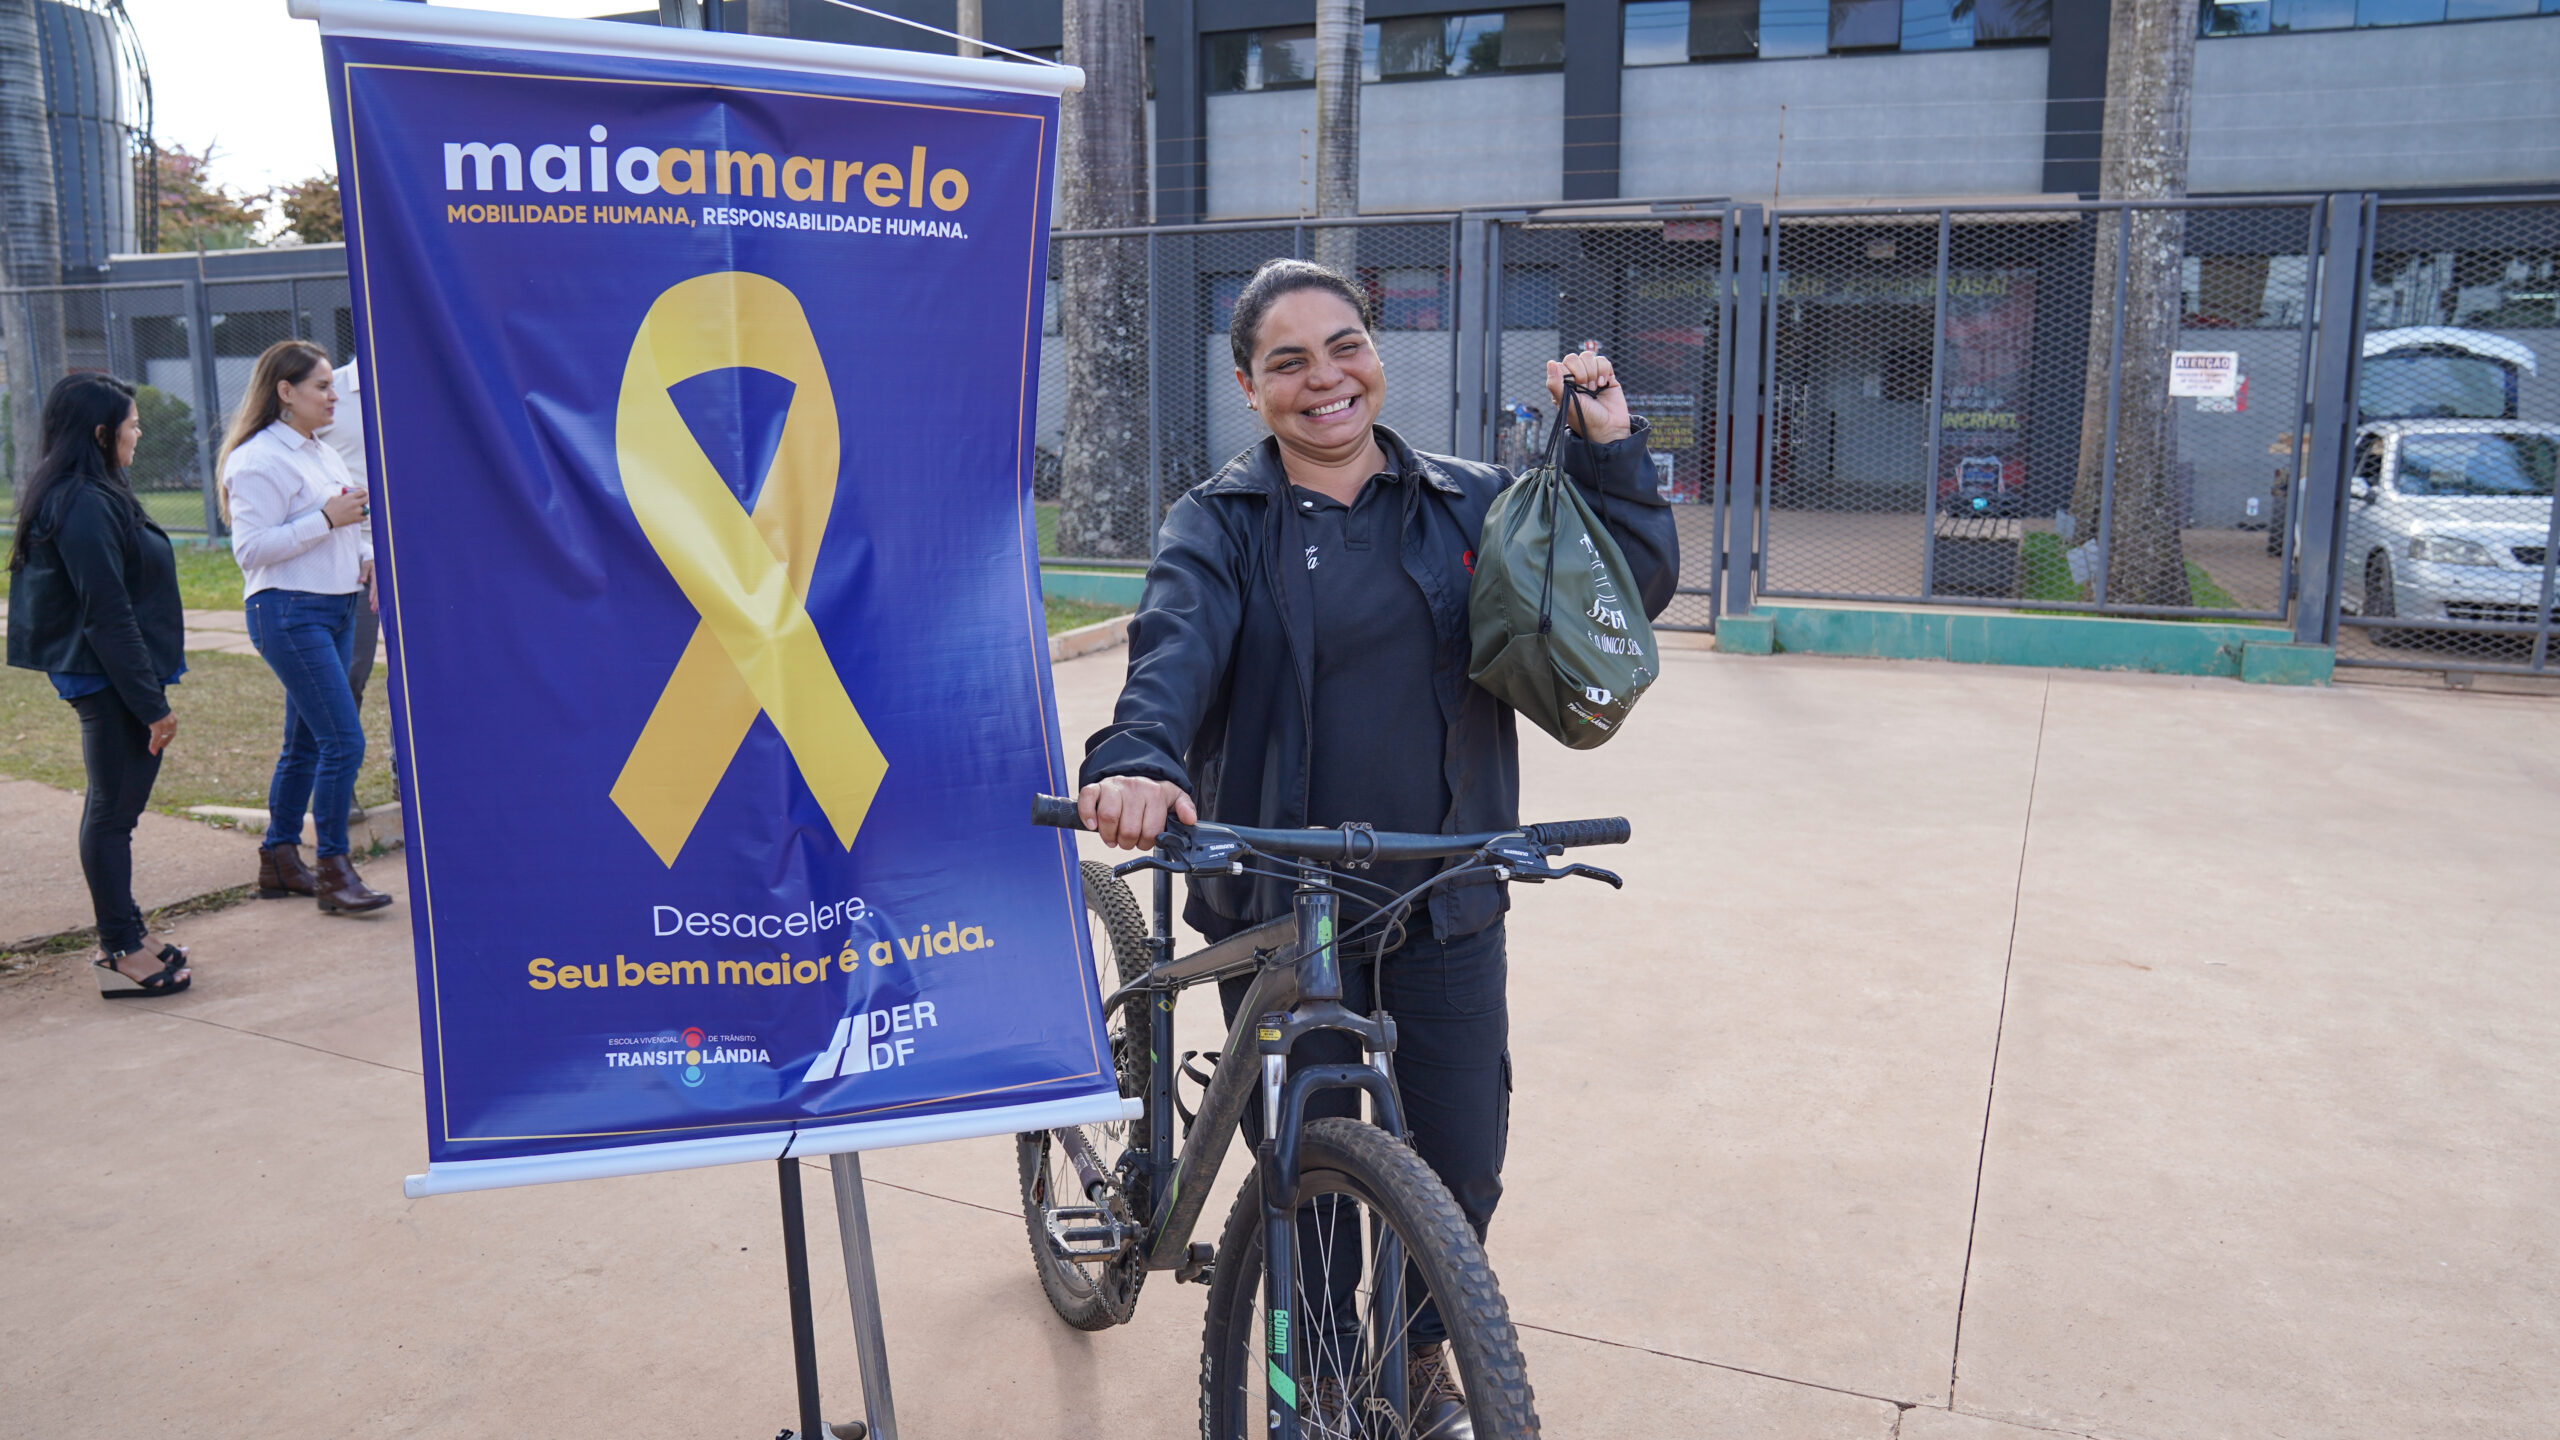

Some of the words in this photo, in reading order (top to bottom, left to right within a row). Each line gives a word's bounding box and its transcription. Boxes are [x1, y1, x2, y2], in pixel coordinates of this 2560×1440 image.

[447, 204, 588, 224] MOBILIDADE
[593, 206, 697, 228] HUMANA,
[702, 206, 882, 235] RESPONSABILIDADE
[885, 217, 969, 240] HUMANA.
[652, 896, 875, 938] Desacelere.
[527, 957, 609, 990] Seu
[616, 954, 710, 987] bem
[717, 952, 832, 985] maior
[838, 938, 860, 973] é
[868, 940, 894, 967] a
[898, 920, 995, 961] vida.
[870, 1000, 938, 1038] DER
[608, 1037, 639, 1046] ESCOLA
[640, 1036, 679, 1044] VIVENCIAL
[720, 1034, 757, 1042] TRÂNSITO
[871, 1037, 915, 1071] DF
[1273, 1309, 1288, 1354] 60mm
